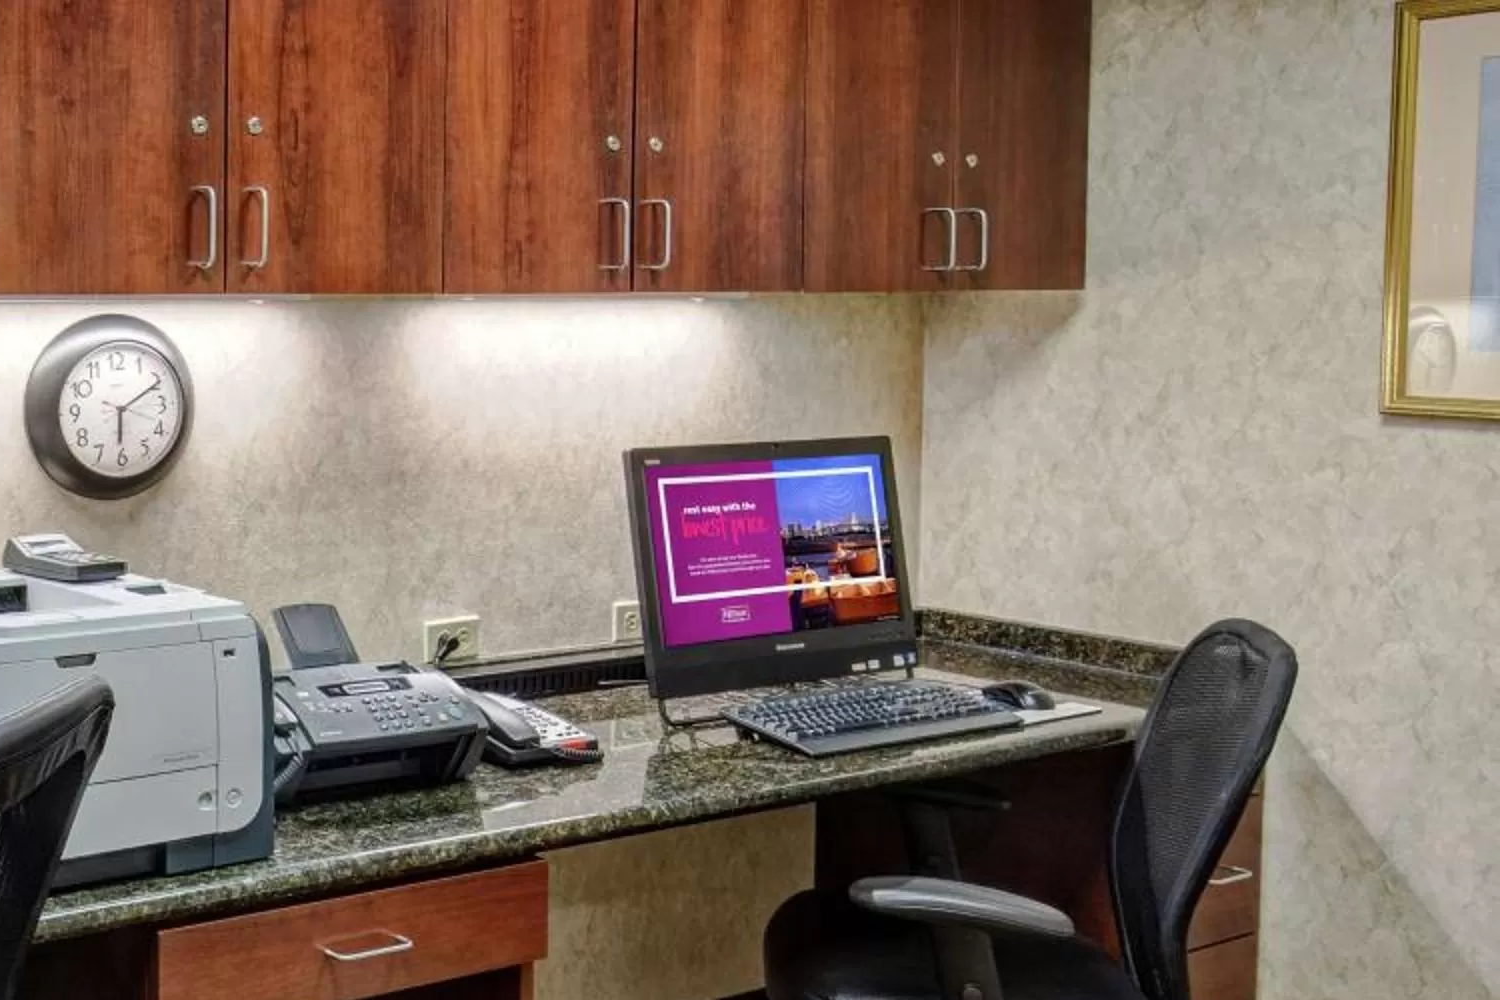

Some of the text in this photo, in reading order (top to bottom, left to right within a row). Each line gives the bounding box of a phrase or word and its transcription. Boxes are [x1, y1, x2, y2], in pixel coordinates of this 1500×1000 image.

[86, 360, 101, 378] 11
[108, 351, 125, 370] 12
[136, 356, 142, 373] 1
[70, 379, 93, 398] 10
[150, 372, 161, 390] 2
[69, 403, 81, 423] 9
[157, 395, 167, 414] 3
[76, 427, 88, 447] 8
[153, 419, 164, 436] 4
[93, 443, 105, 462] 7
[140, 437, 150, 457] 5
[117, 448, 128, 466] 6
